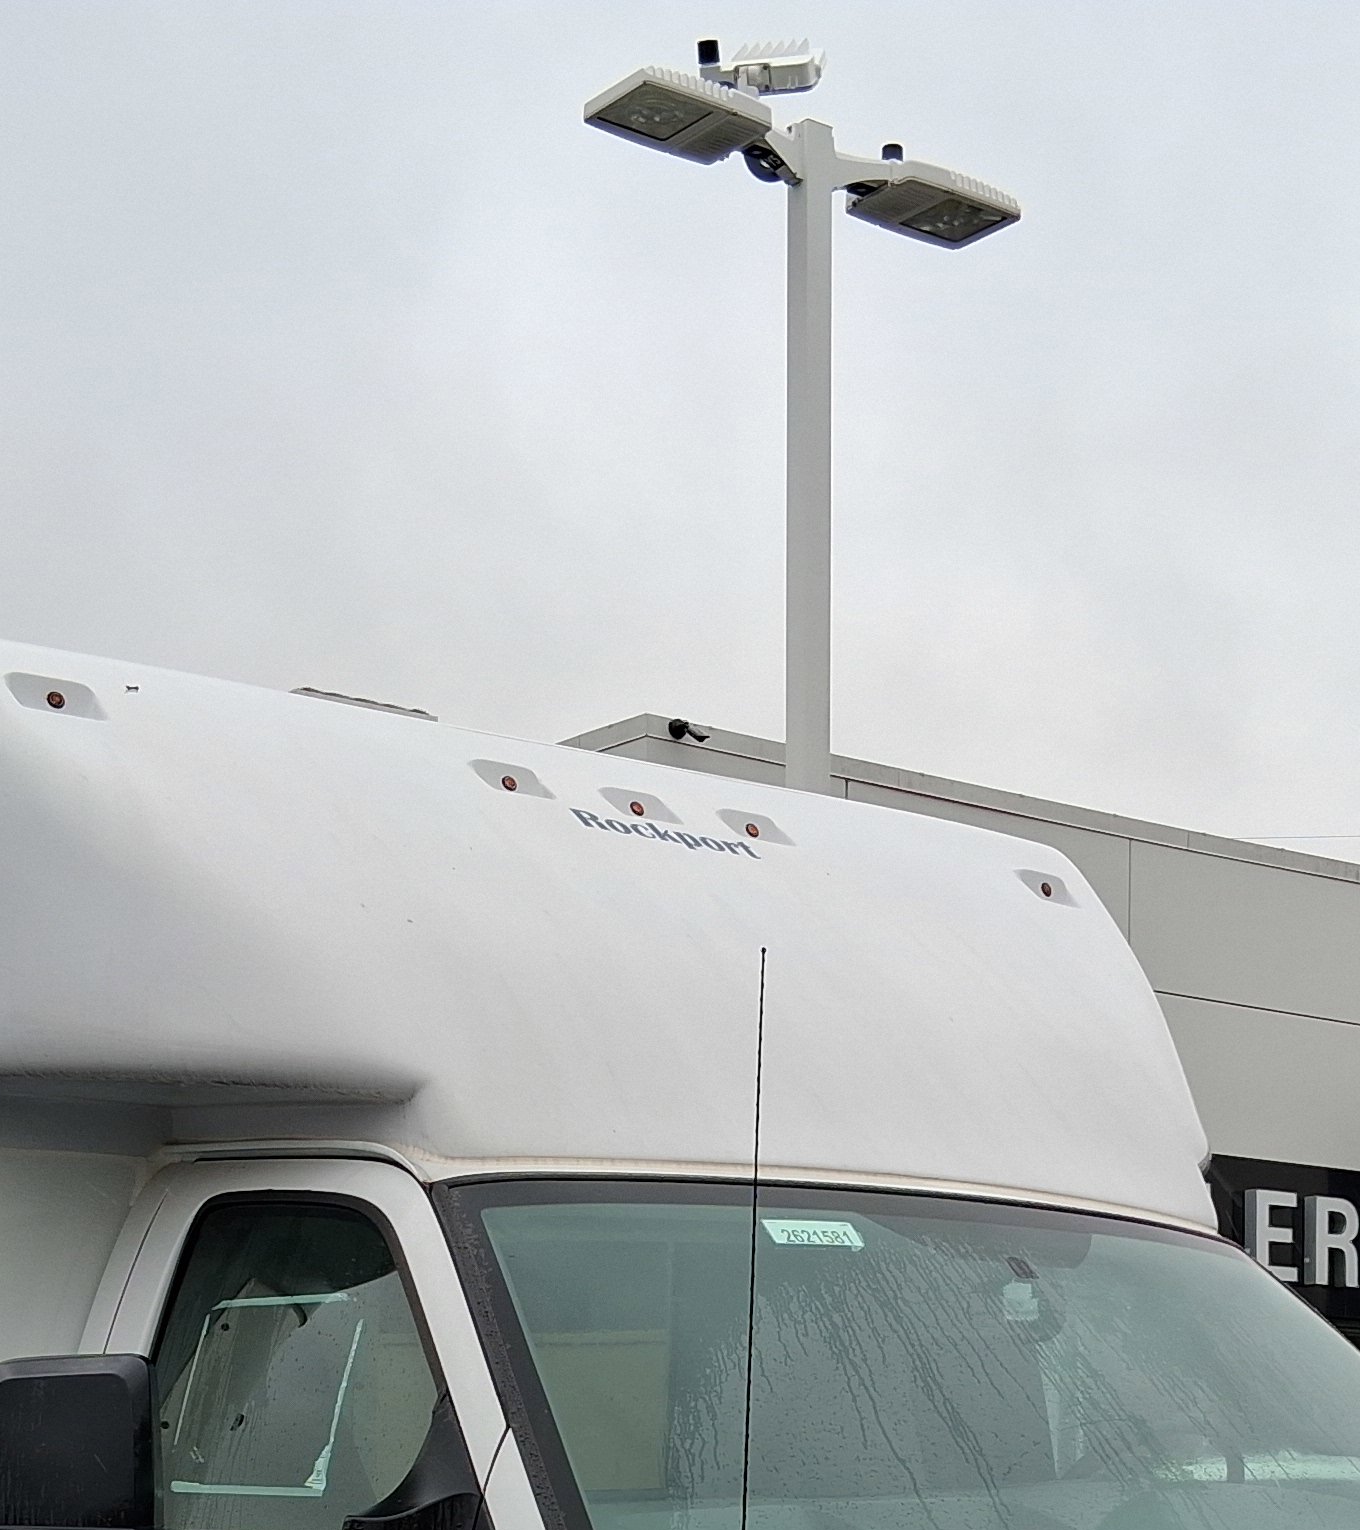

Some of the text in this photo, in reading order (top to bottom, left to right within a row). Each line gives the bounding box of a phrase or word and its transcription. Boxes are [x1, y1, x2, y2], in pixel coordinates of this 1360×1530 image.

[569, 807, 761, 860] Rockport
[780, 1228, 854, 1245] 2621581
[1244, 1188, 1359, 1288] ER
